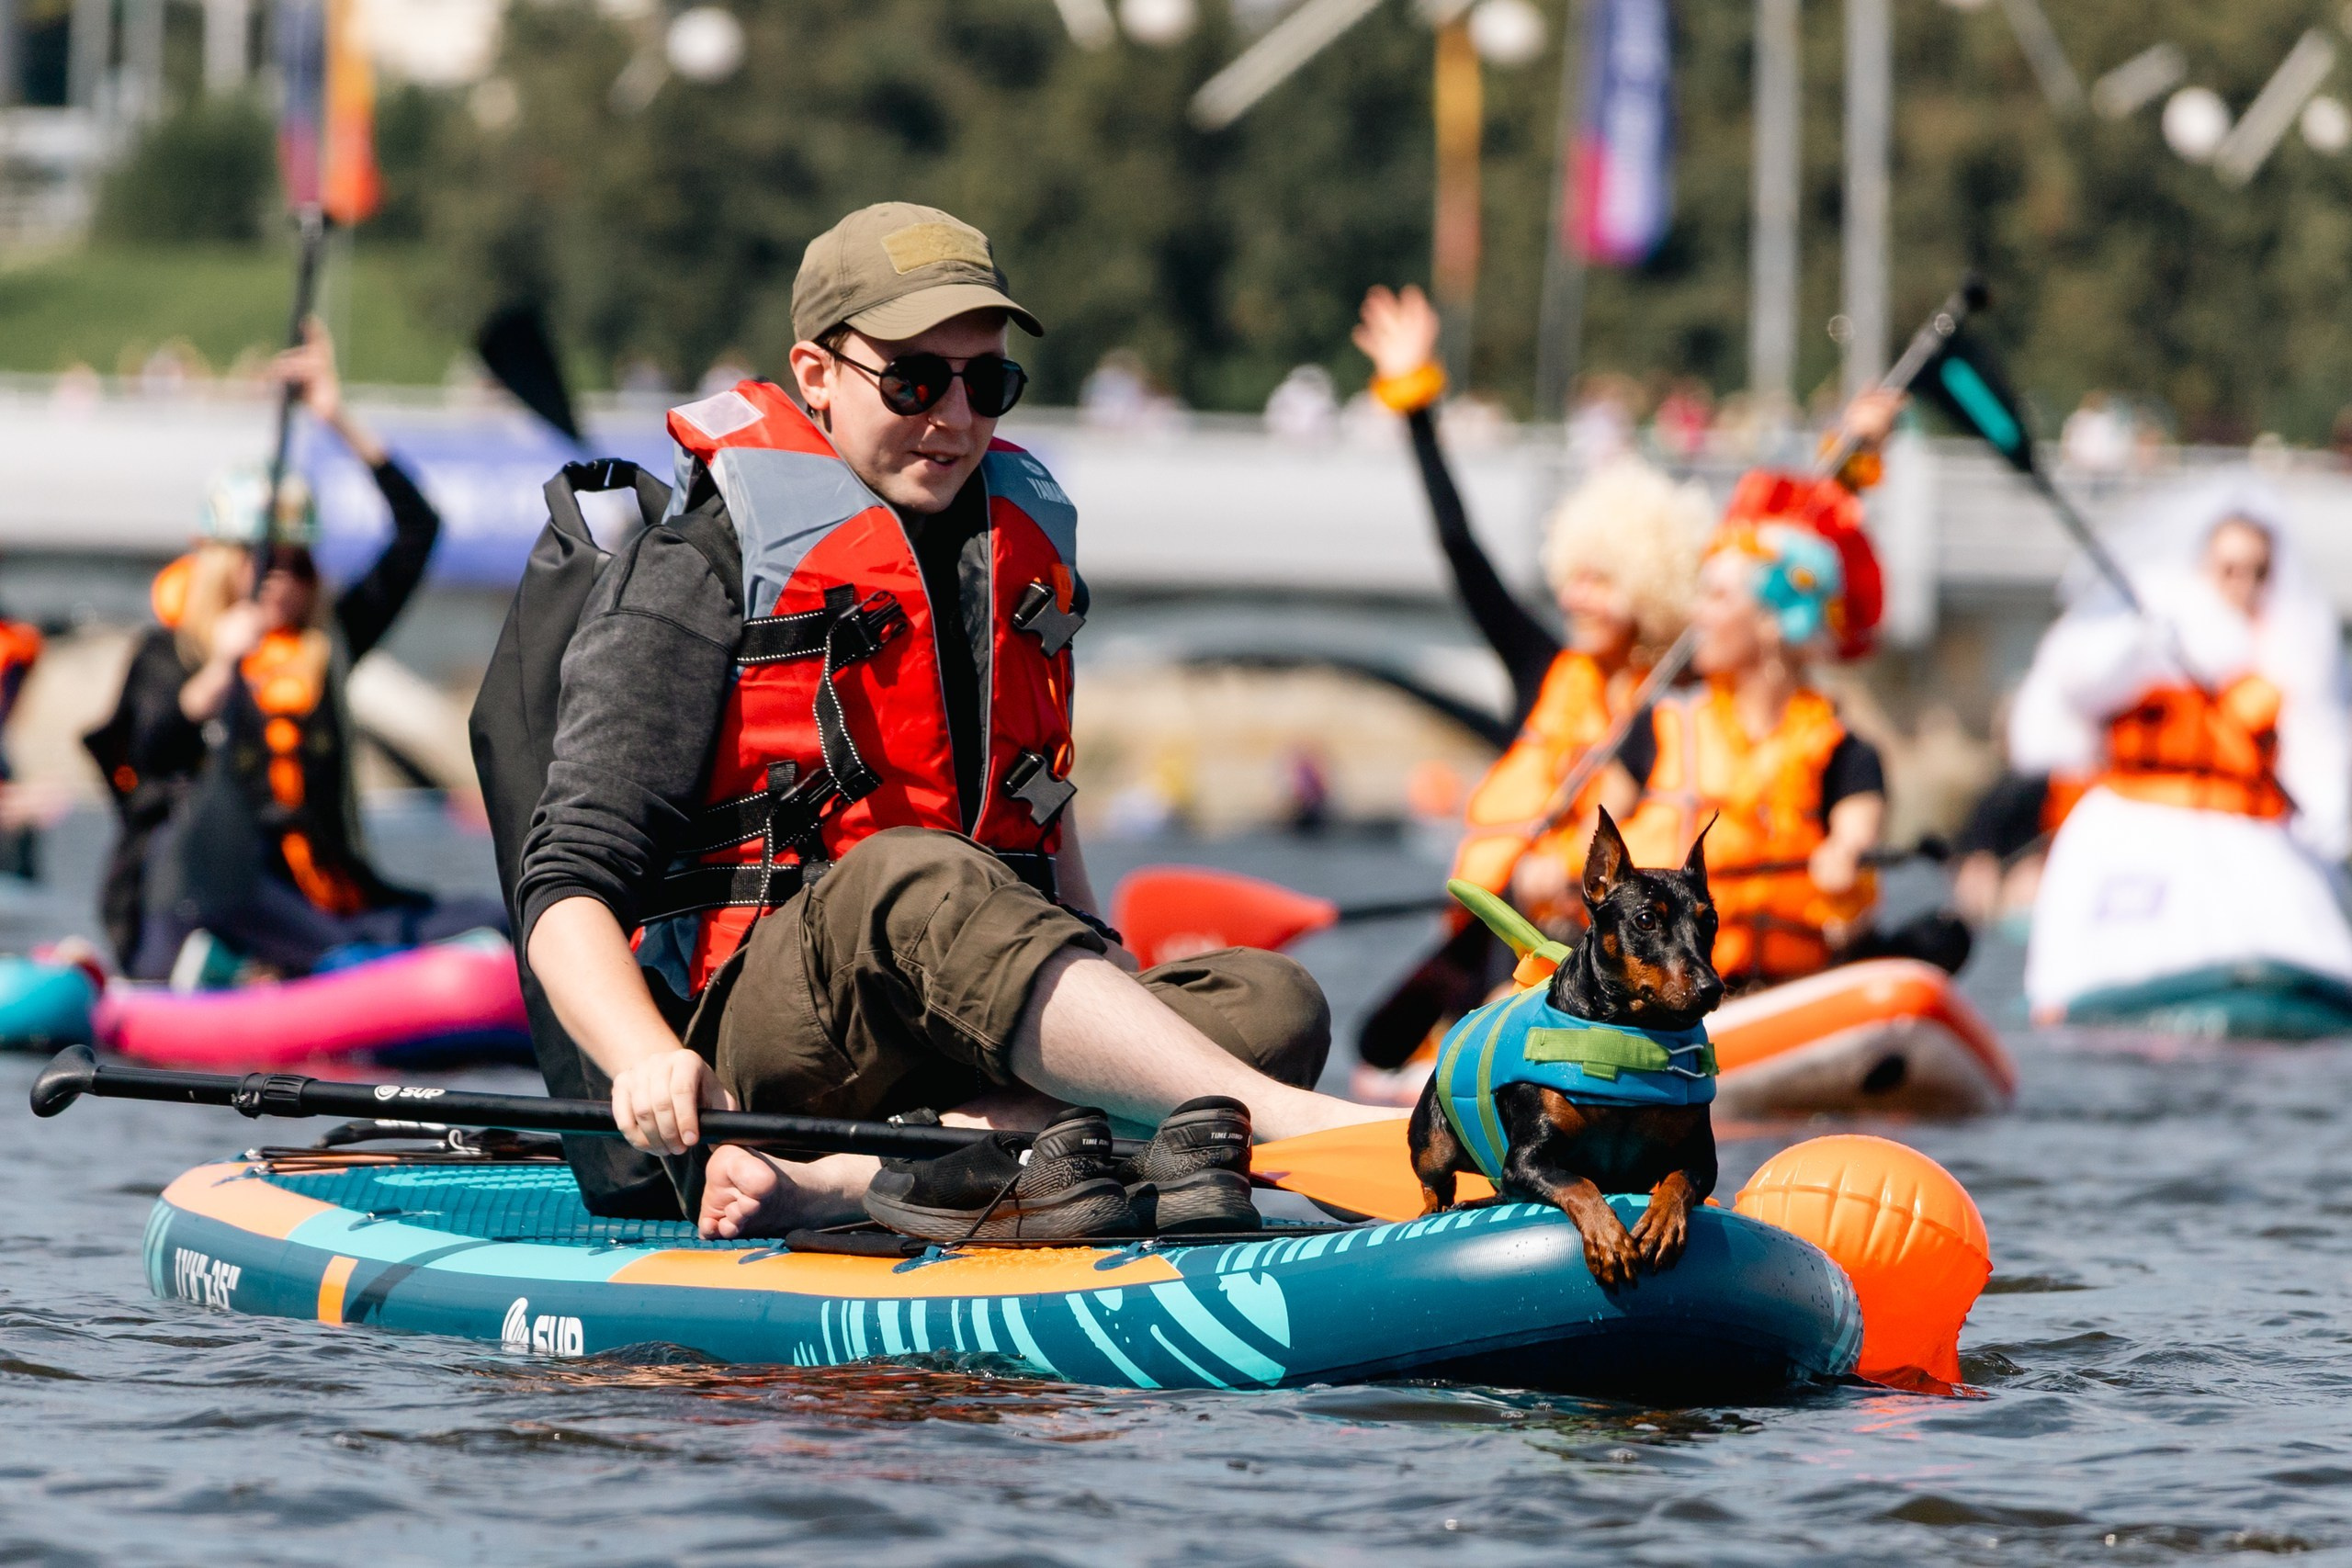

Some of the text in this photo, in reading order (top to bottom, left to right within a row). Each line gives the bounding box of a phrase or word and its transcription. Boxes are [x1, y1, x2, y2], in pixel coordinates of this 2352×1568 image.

[399, 1087, 446, 1100] SUP
[1210, 1132, 1227, 1140] TIME
[533, 1314, 583, 1356] SUP
